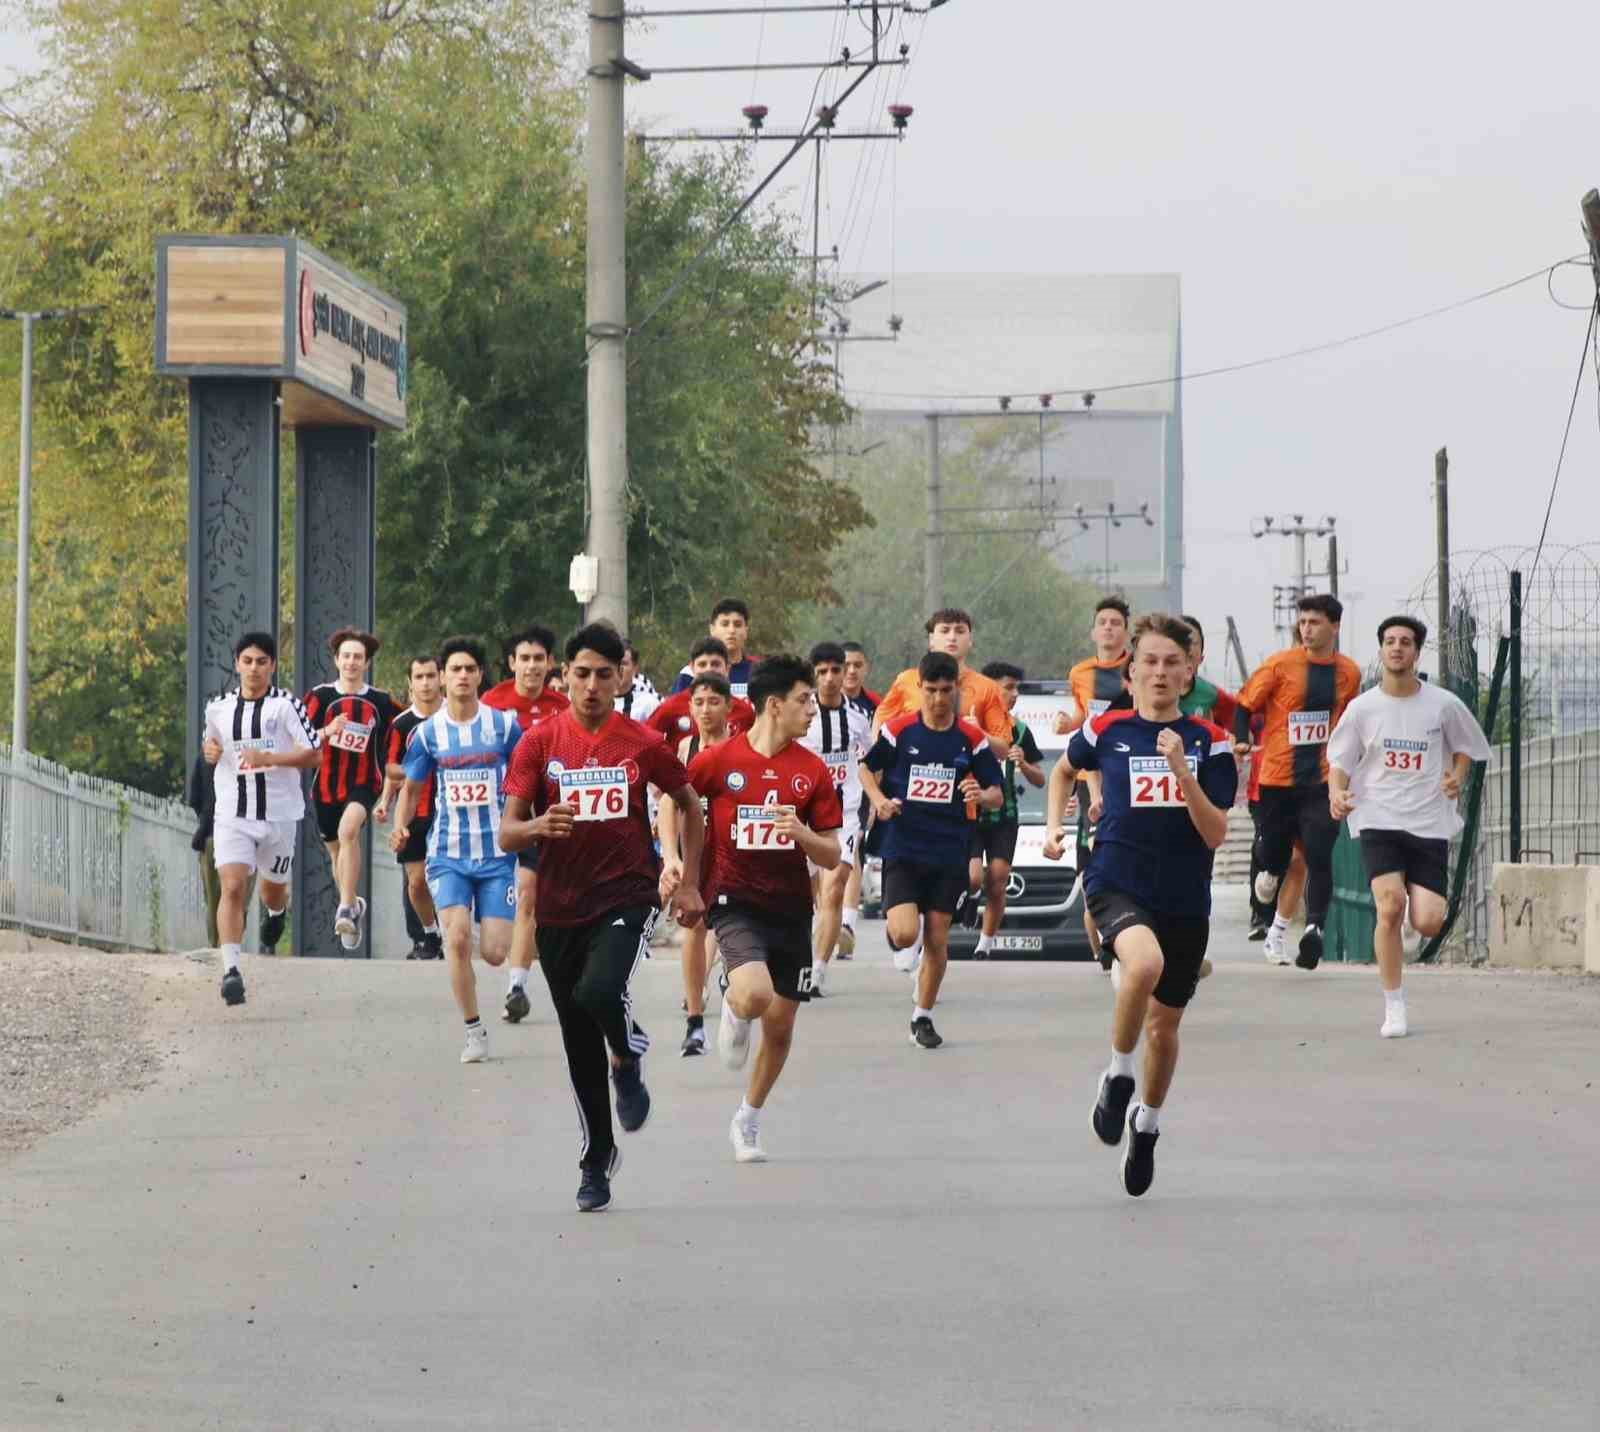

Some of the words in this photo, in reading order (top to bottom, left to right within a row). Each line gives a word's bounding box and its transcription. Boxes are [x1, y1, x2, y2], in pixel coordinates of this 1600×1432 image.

[1294, 725, 1327, 741] 170
[1384, 751, 1422, 770] 331
[449, 783, 489, 803] 332
[911, 779, 951, 799] 222
[567, 788, 624, 817] 176
[270, 855, 291, 874] 10
